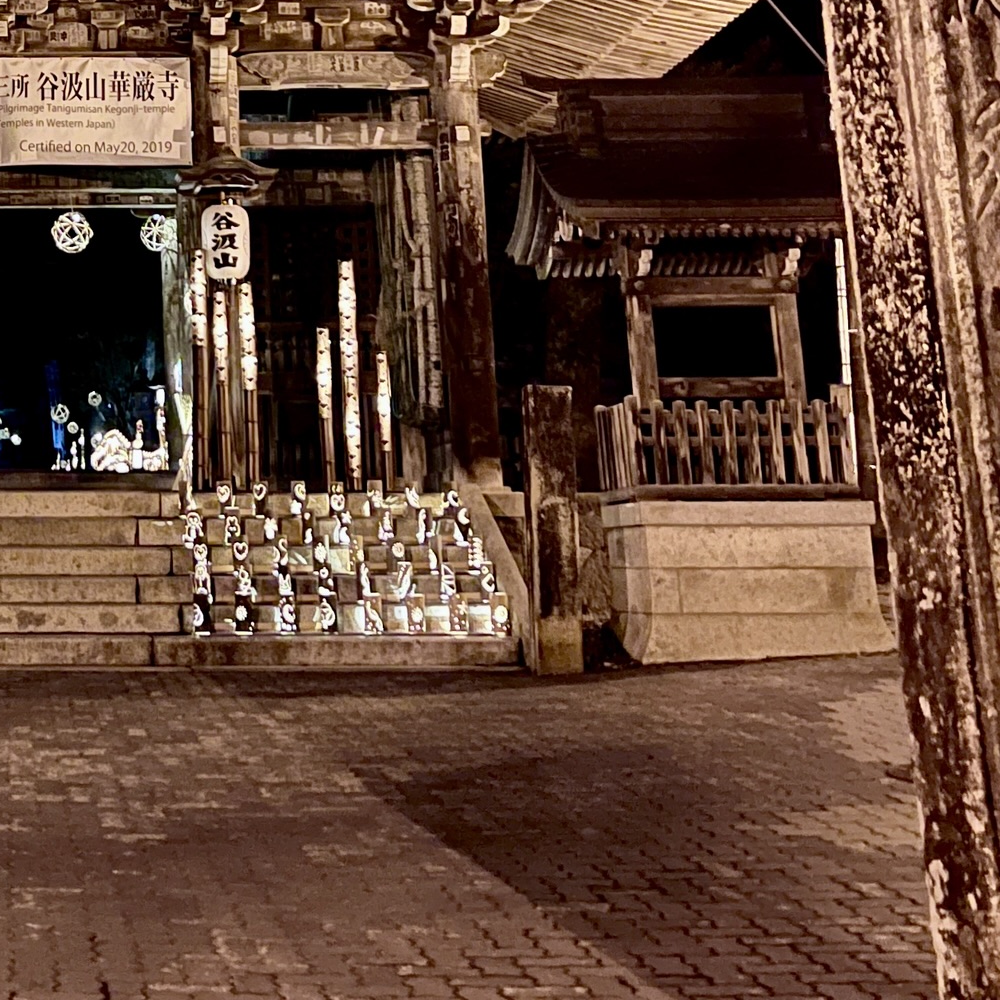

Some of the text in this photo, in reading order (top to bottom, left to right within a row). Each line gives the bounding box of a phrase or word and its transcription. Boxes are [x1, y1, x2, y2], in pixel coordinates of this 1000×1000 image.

[37, 70, 179, 101] 谷汲山華厳寺
[47, 104, 102, 115] Tanigumisan
[105, 104, 176, 116] Kegonji-temple
[36, 118, 45, 127] in
[47, 118, 84, 128] Western
[85, 119, 116, 130] Japan)
[19, 139, 172, 155] Certified on May20, 2019
[211, 211, 240, 269] 谷汲山
